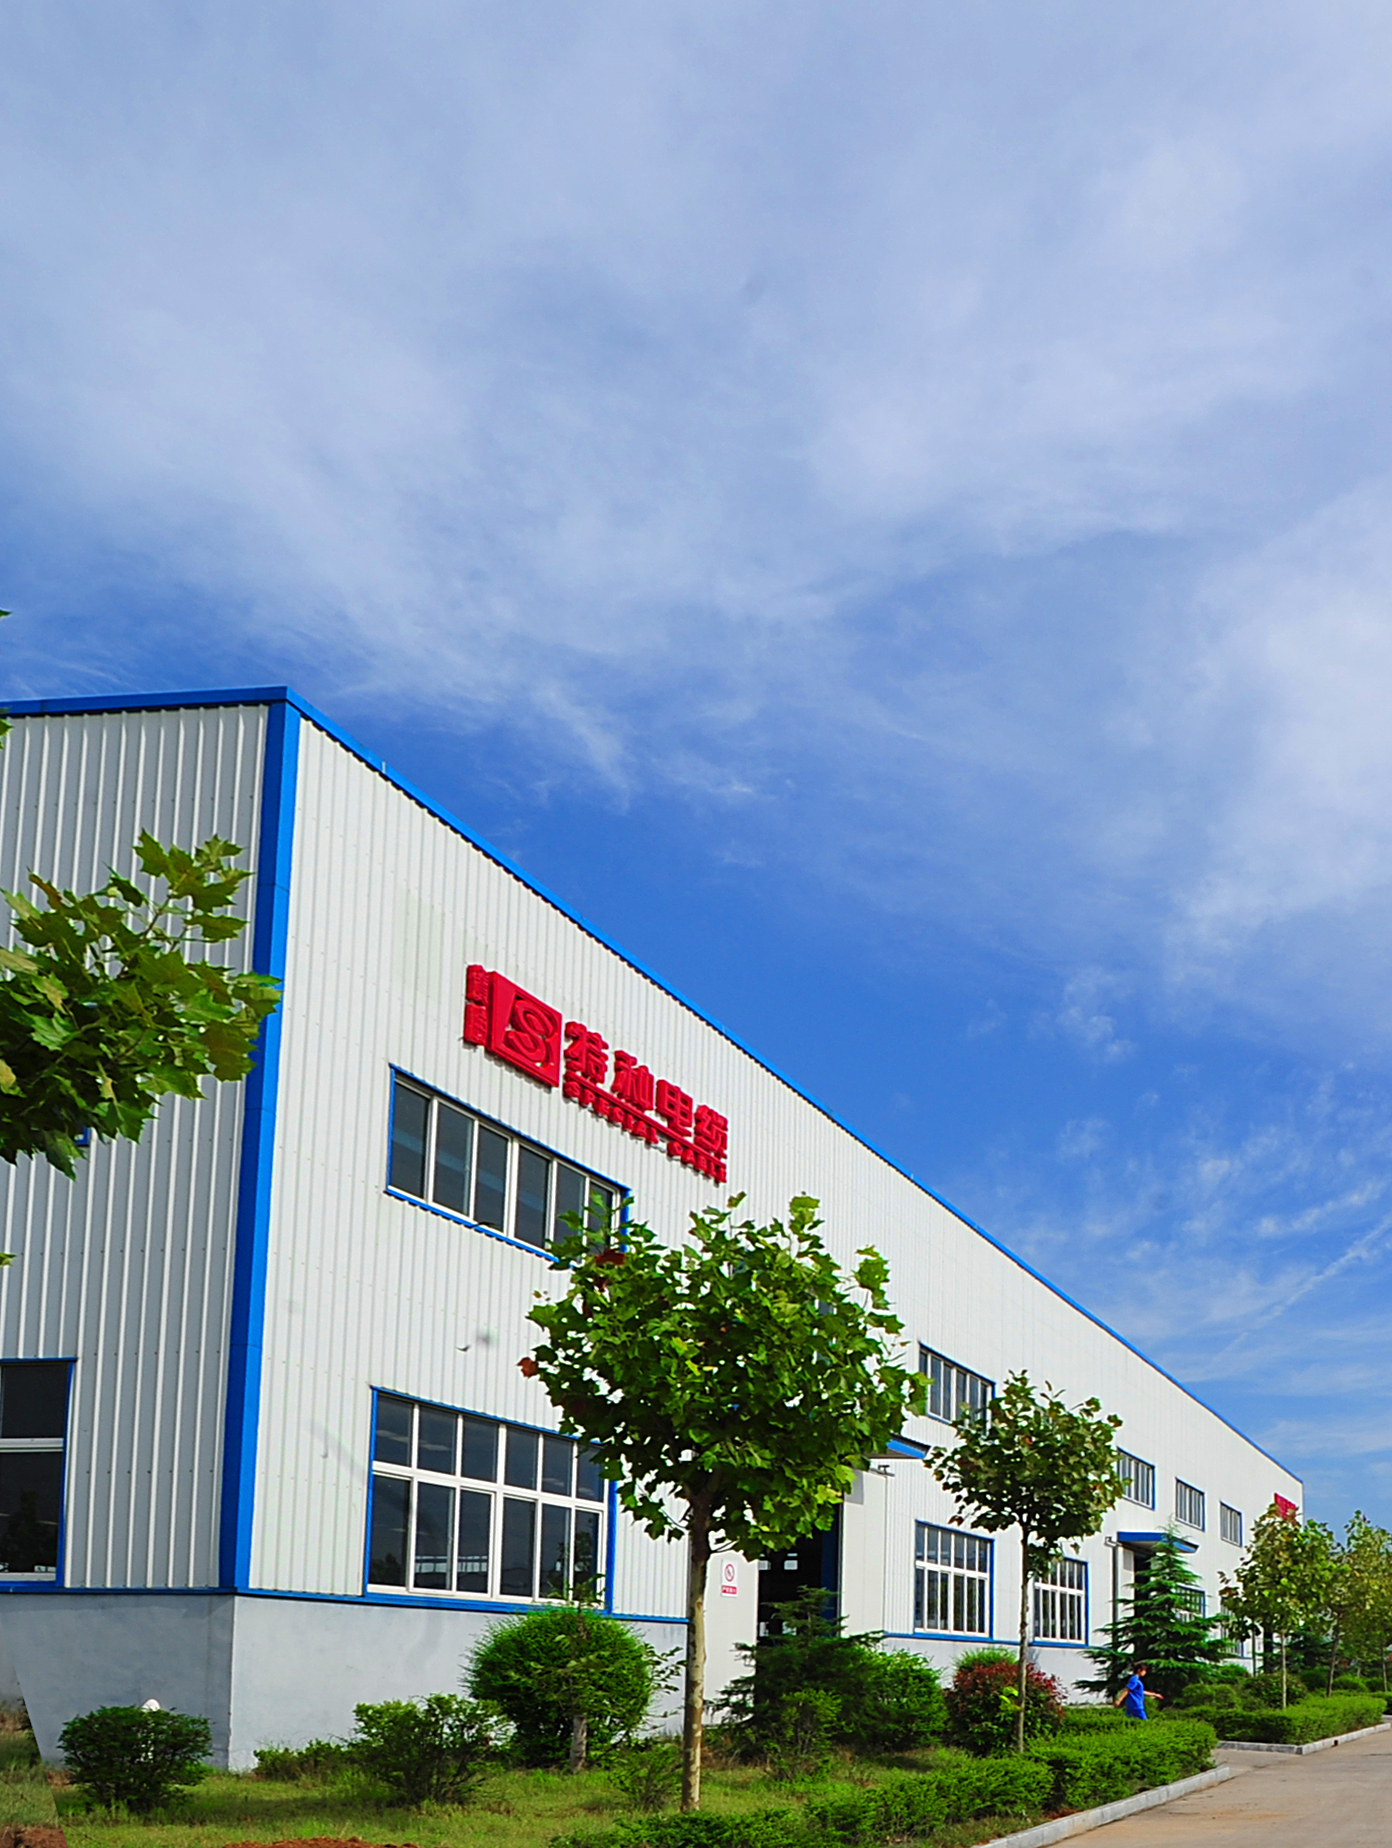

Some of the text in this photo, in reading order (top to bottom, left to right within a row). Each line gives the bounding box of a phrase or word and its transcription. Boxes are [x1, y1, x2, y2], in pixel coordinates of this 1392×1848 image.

[562, 1081, 727, 1183] SPECIAL CABLE
[564, 1020, 728, 1158] 特种电缆
